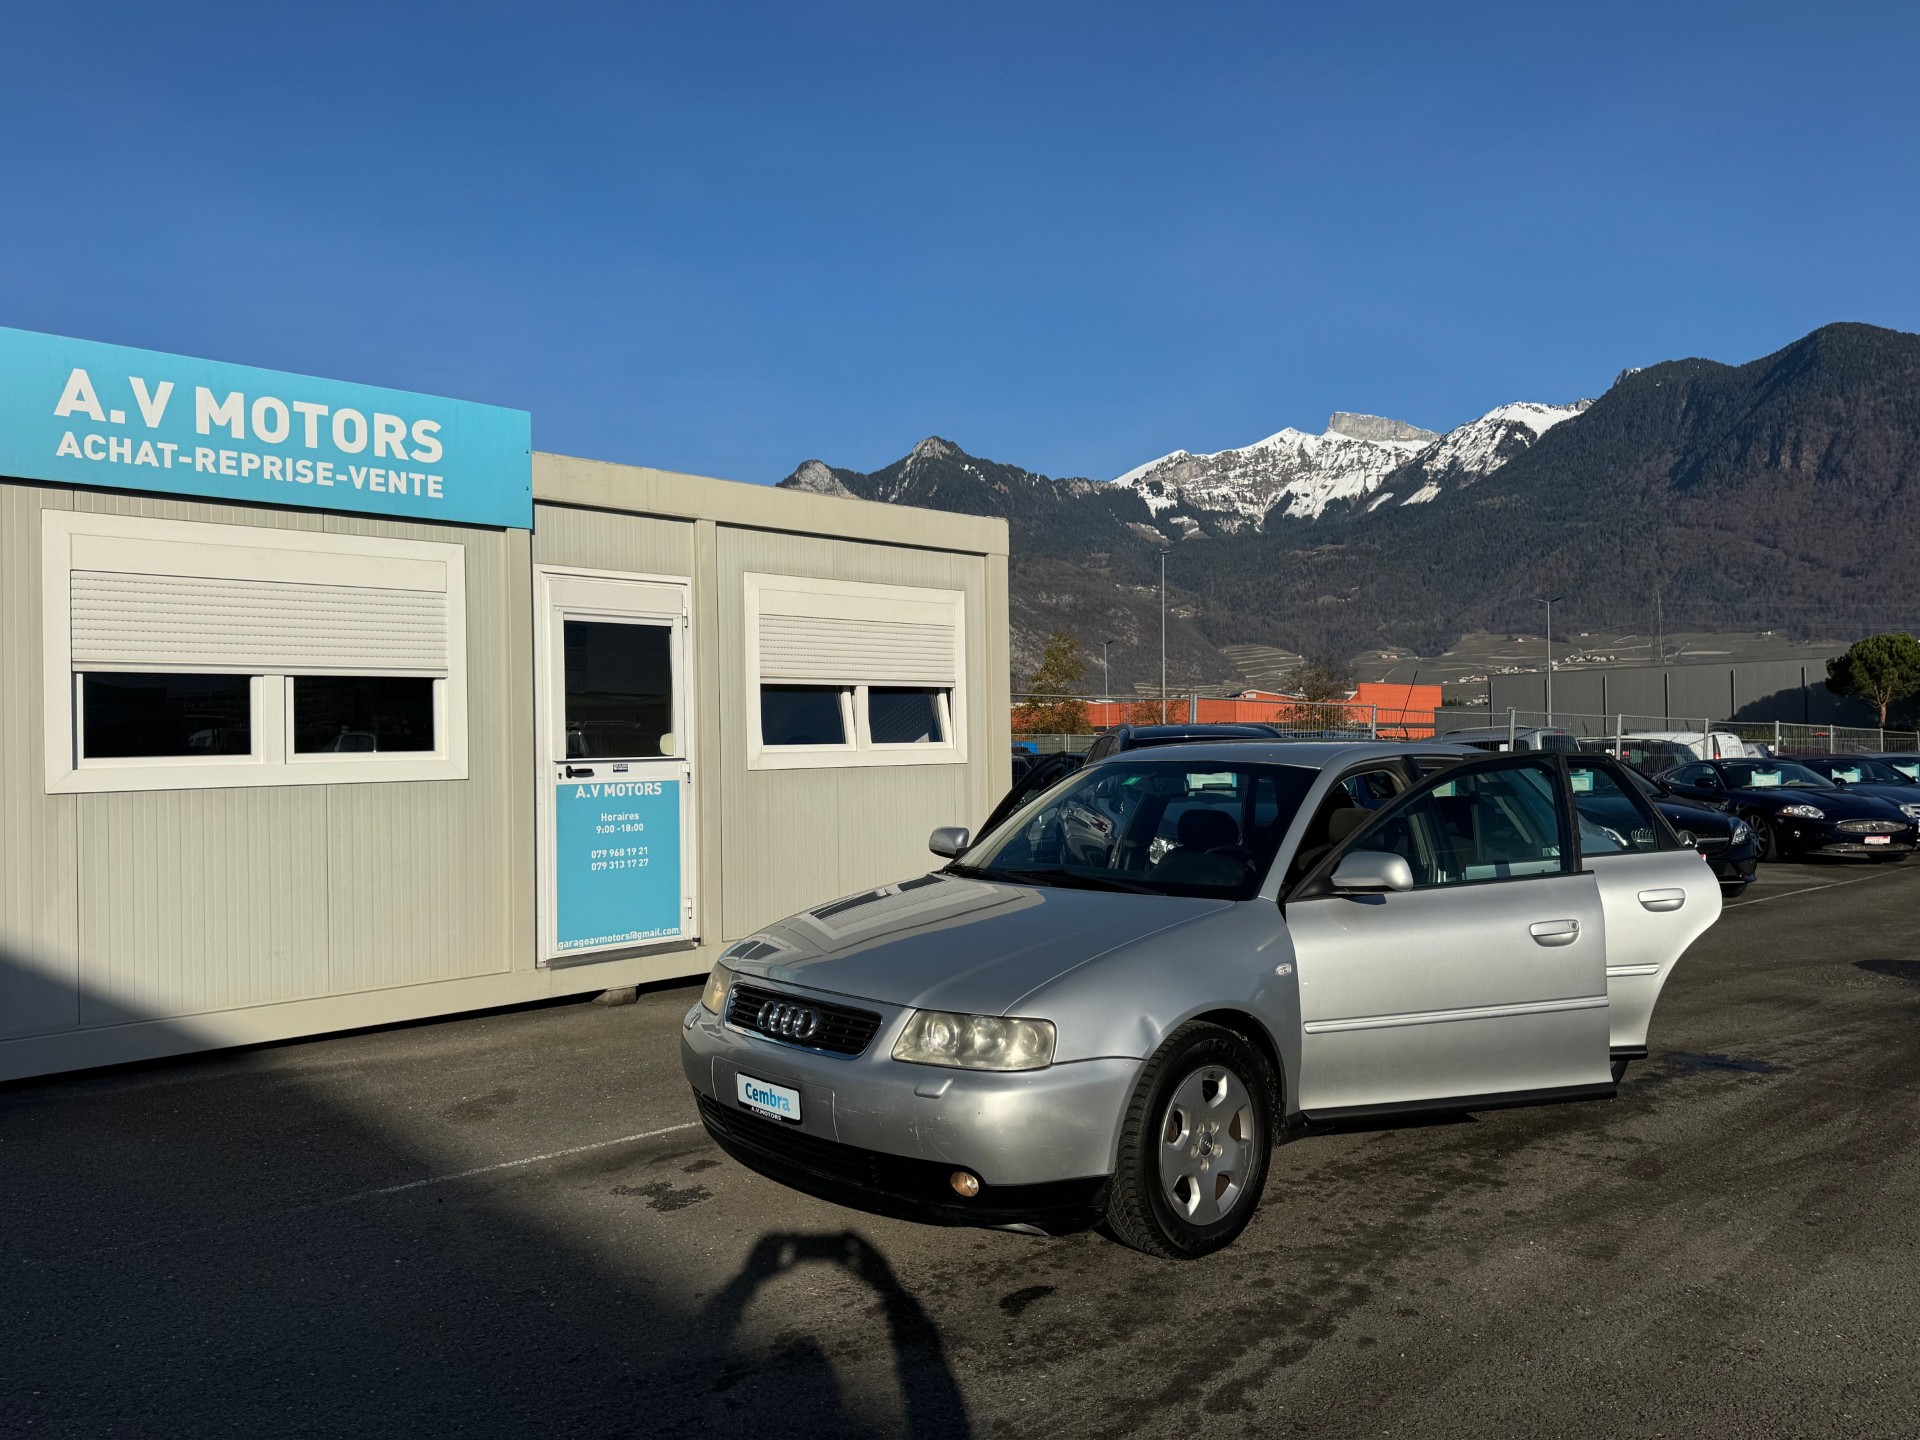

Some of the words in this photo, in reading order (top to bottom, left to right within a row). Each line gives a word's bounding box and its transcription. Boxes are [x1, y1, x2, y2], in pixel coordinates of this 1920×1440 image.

[54, 367, 175, 428] A.V
[195, 386, 444, 463] MOTORS
[55, 431, 444, 499] ACHAT-REPRISE-VENTE
[576, 785, 600, 798] A.V
[604, 782, 662, 797] MOTORS
[600, 812, 640, 822] Horaires
[596, 825, 615, 834] 9:00
[591, 849, 608, 859] 079
[609, 848, 625, 857] 968
[627, 847, 637, 856] 19
[638, 846, 648, 855] 21
[591, 861, 608, 871] 079
[609, 860, 625, 869] 313
[627, 859, 637, 868] 17
[638, 858, 649, 867] 27
[558, 927, 680, 950] garageavmotors@gmail.com
[745, 1083, 790, 1111] Cembra
